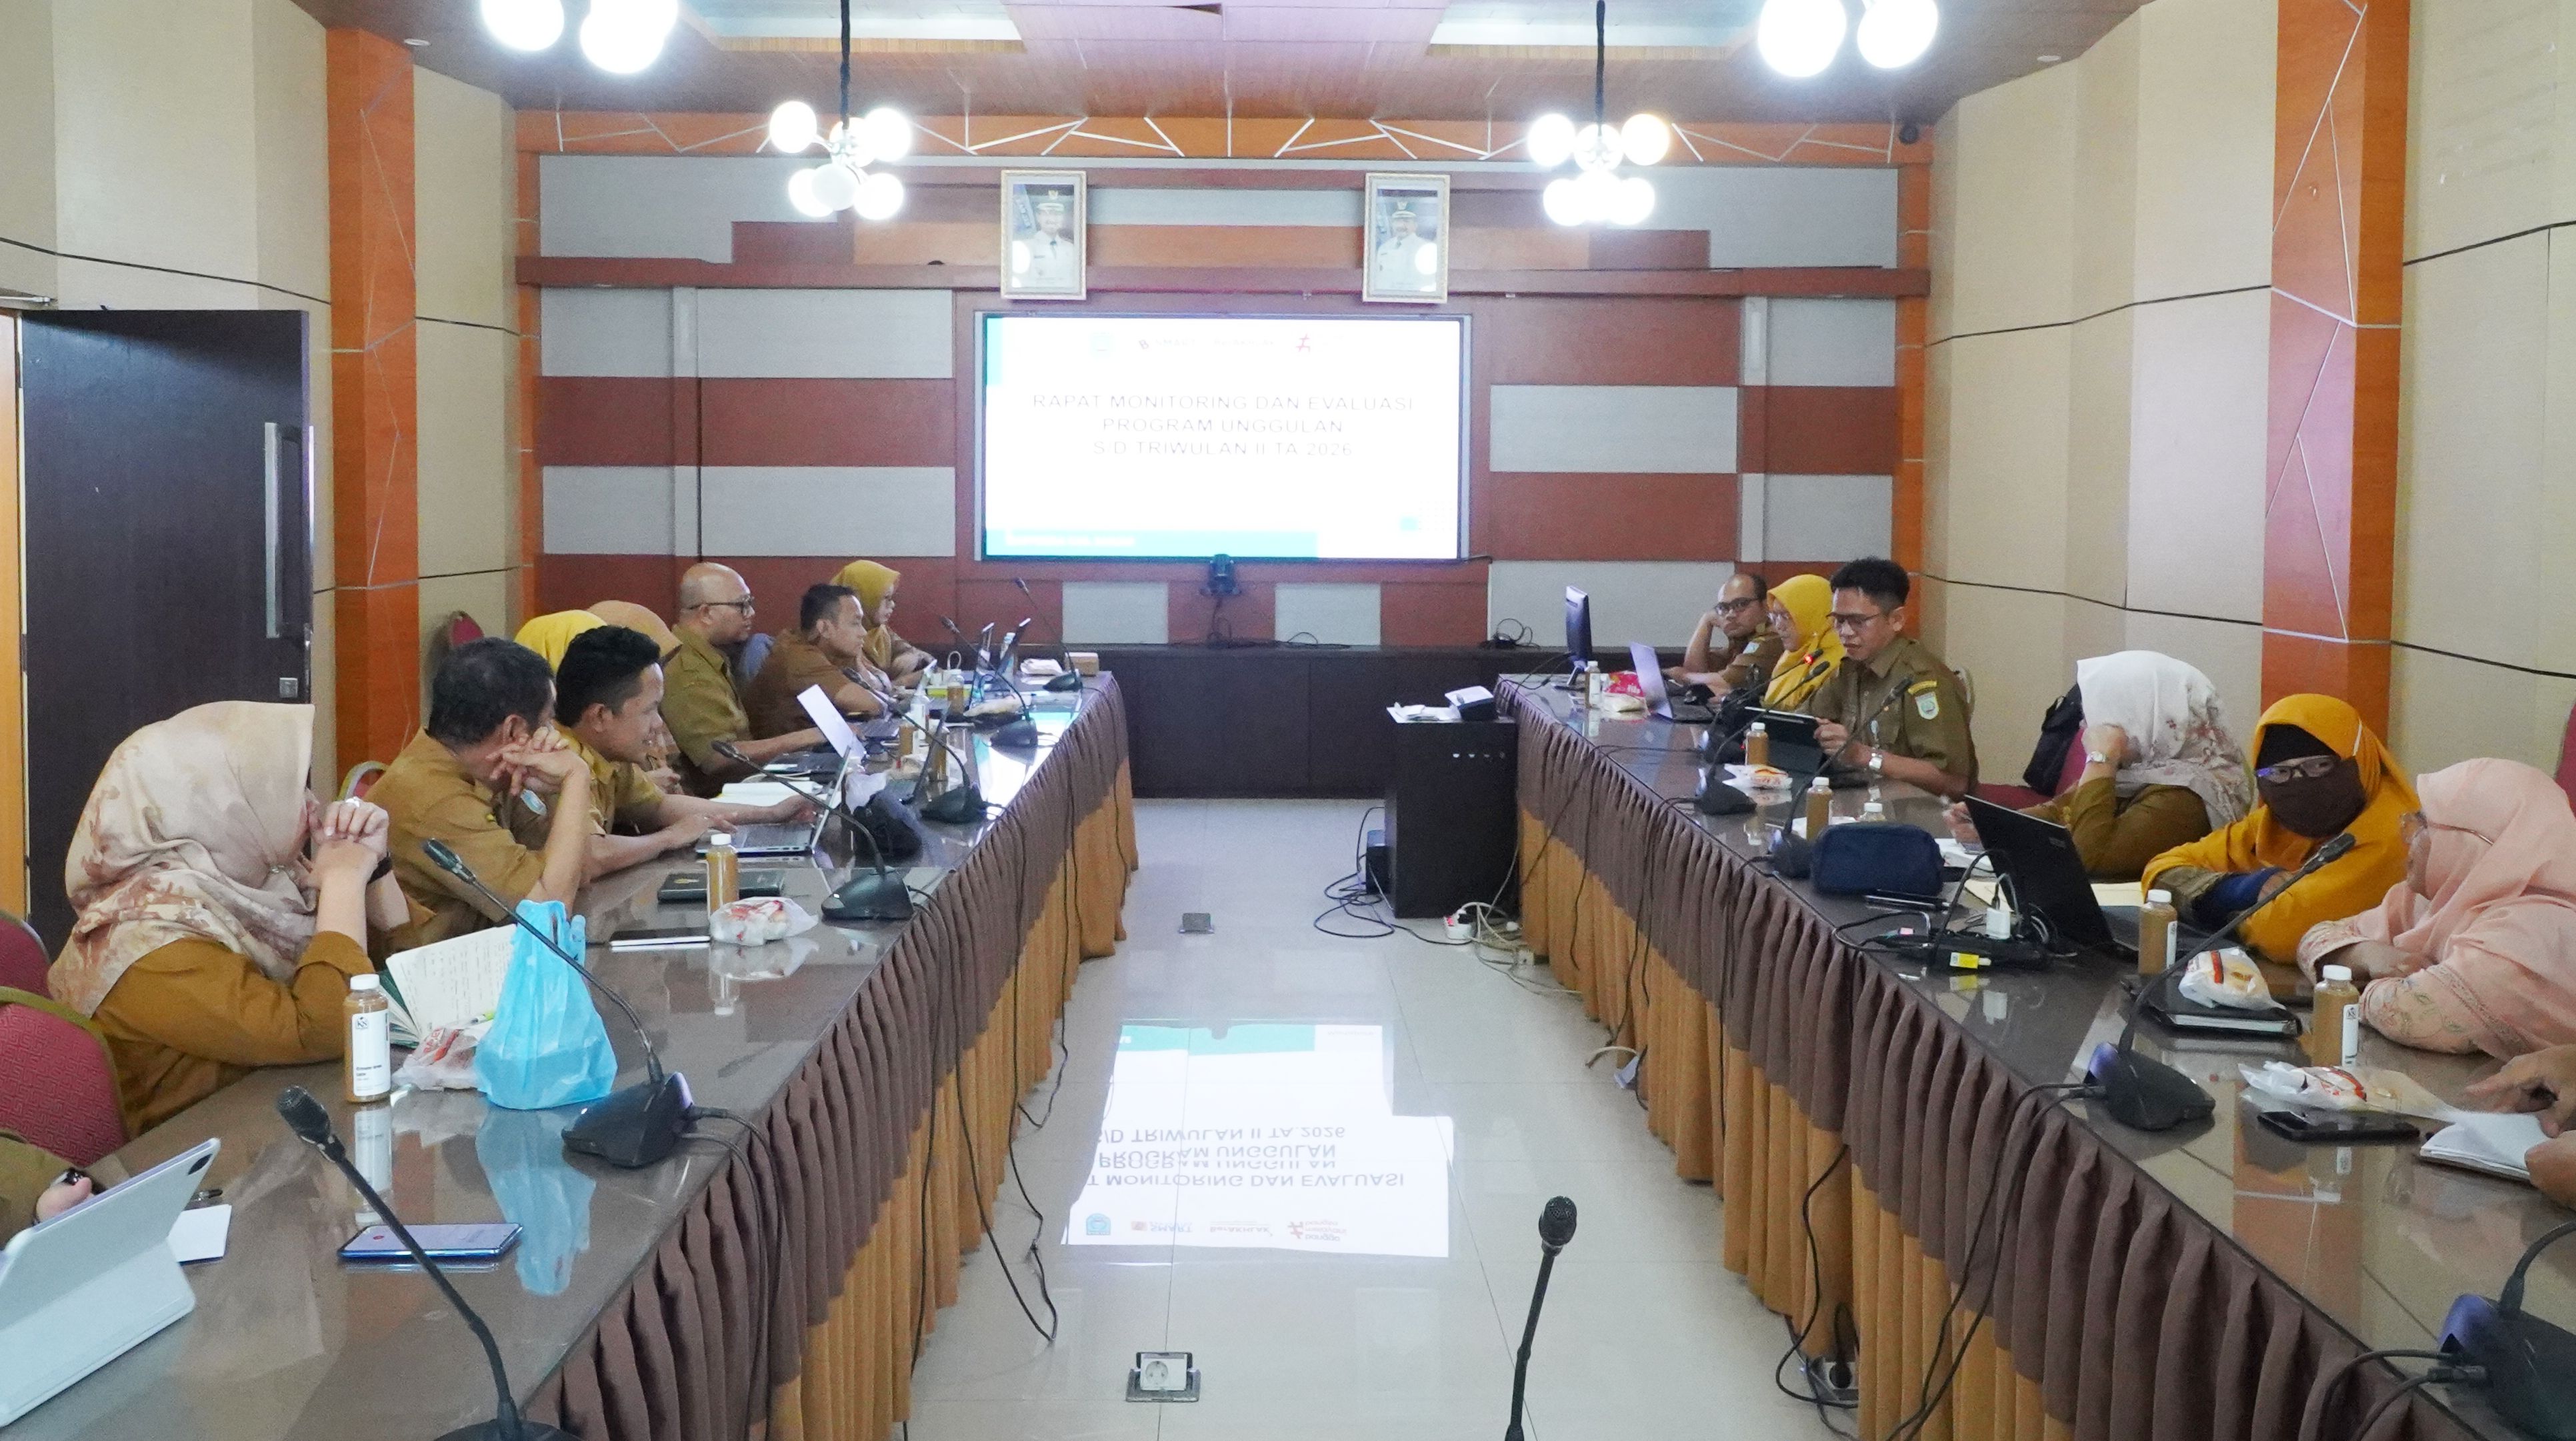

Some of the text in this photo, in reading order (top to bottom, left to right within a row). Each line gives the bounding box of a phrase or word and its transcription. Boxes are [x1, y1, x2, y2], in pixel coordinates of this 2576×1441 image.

[1033, 395, 1413, 410] RAPAT MONITORING DAN EVALUASI
[1103, 419, 1343, 433] PROGRAM UNGGULAN
[1135, 442, 1247, 455] TRIWULAN
[1256, 443, 1265, 455] II
[1307, 443, 1353, 456] 2026
